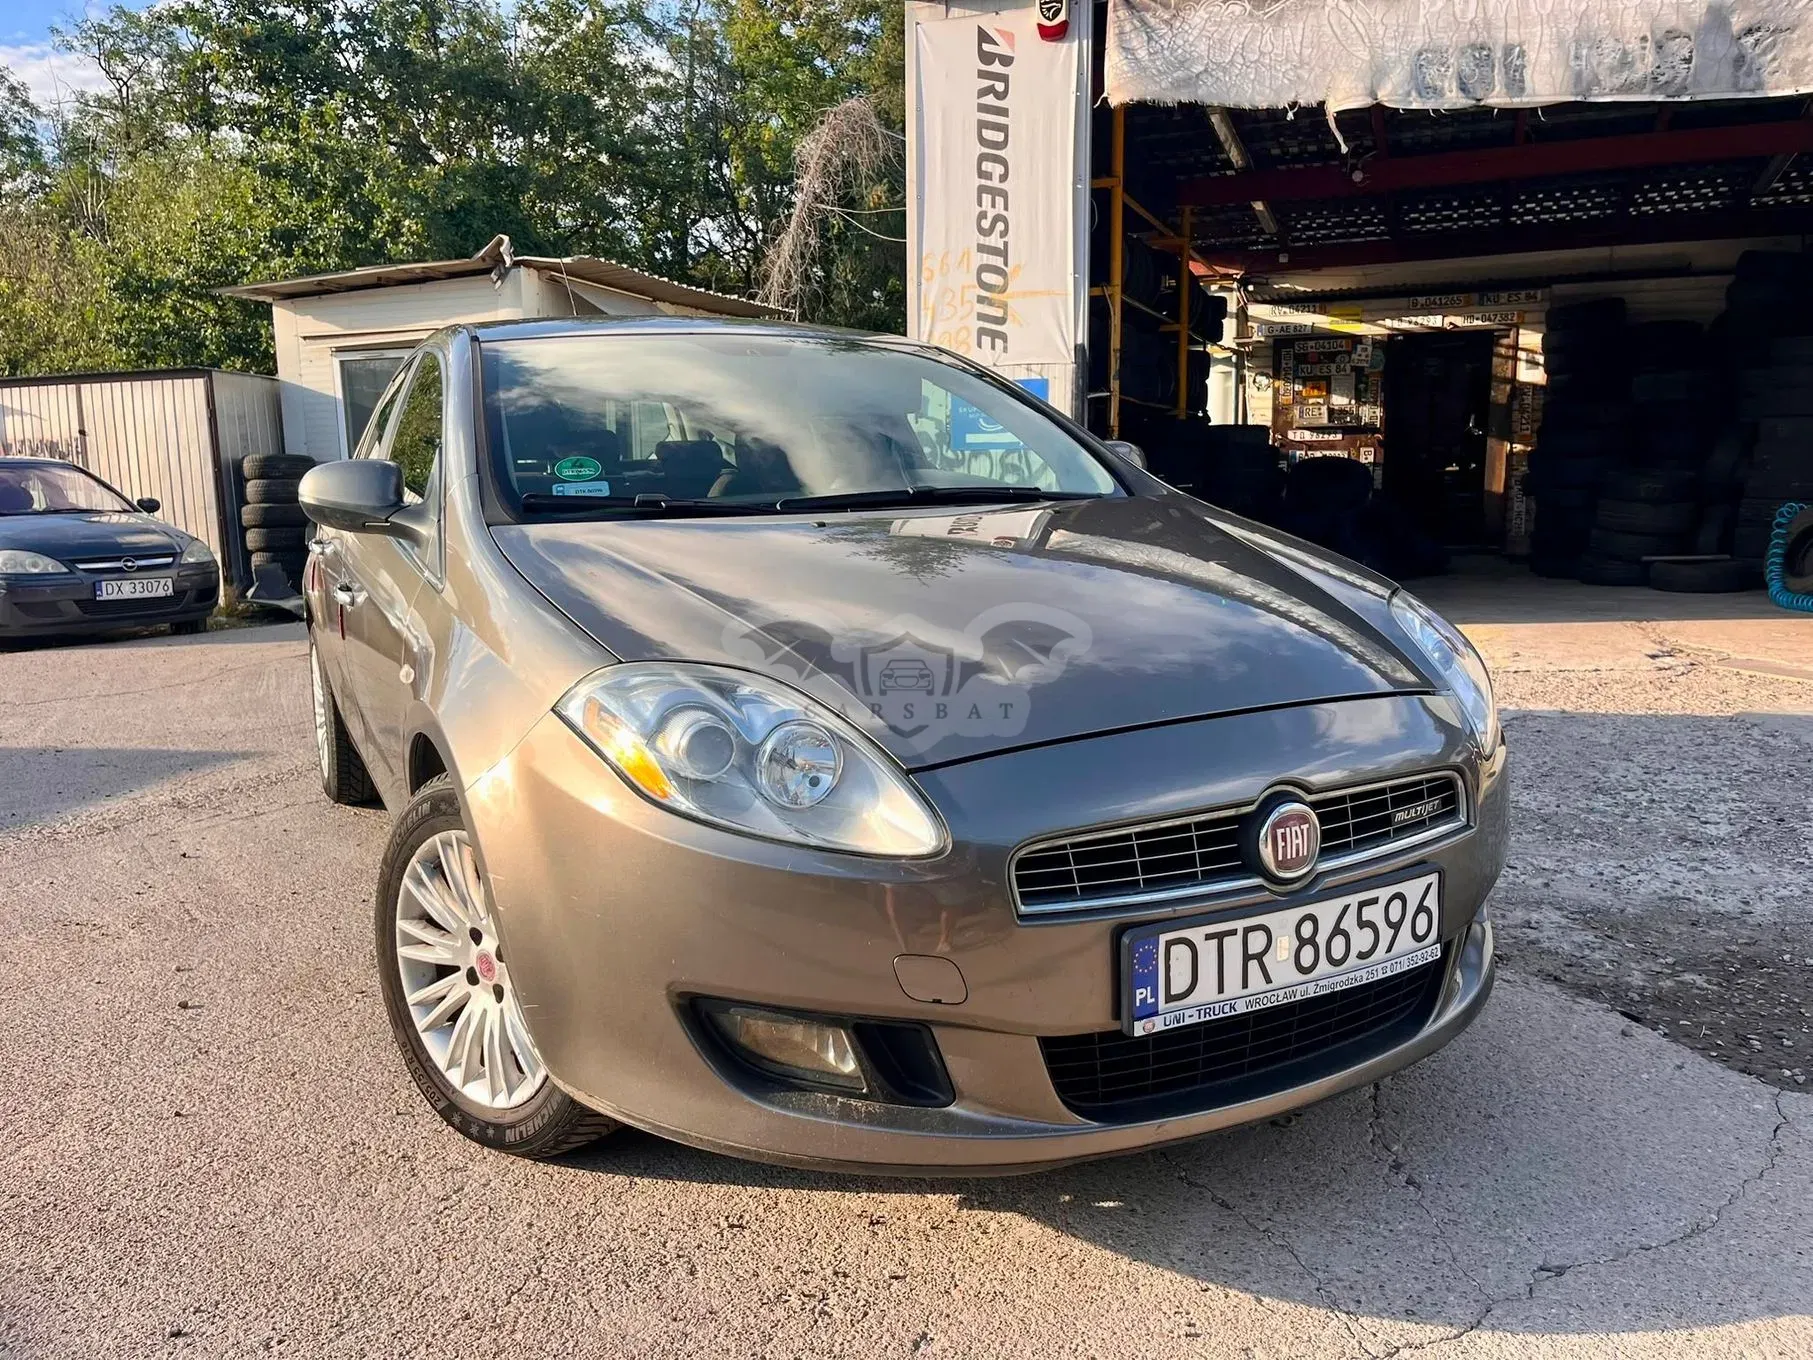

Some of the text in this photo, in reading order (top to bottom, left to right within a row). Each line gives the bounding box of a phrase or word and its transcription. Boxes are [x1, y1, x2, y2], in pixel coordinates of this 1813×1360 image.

[976, 23, 1015, 355] BRIDGESTONE
[105, 582, 124, 596] DX
[129, 580, 170, 595] 33076
[1394, 800, 1441, 823] MULTIJET
[1276, 823, 1310, 861] FIAT
[1164, 882, 1434, 1004] DTR 86596
[1135, 986, 1156, 1007] PL
[1245, 990, 1298, 1010] WROCŁAW
[1300, 987, 1311, 998] ul.
[1313, 974, 1364, 994] Żmigrodzka
[1365, 968, 1379, 981] 251
[1407, 948, 1439, 968] 352-92-62
[504, 1089, 564, 1143] MICHELIN
